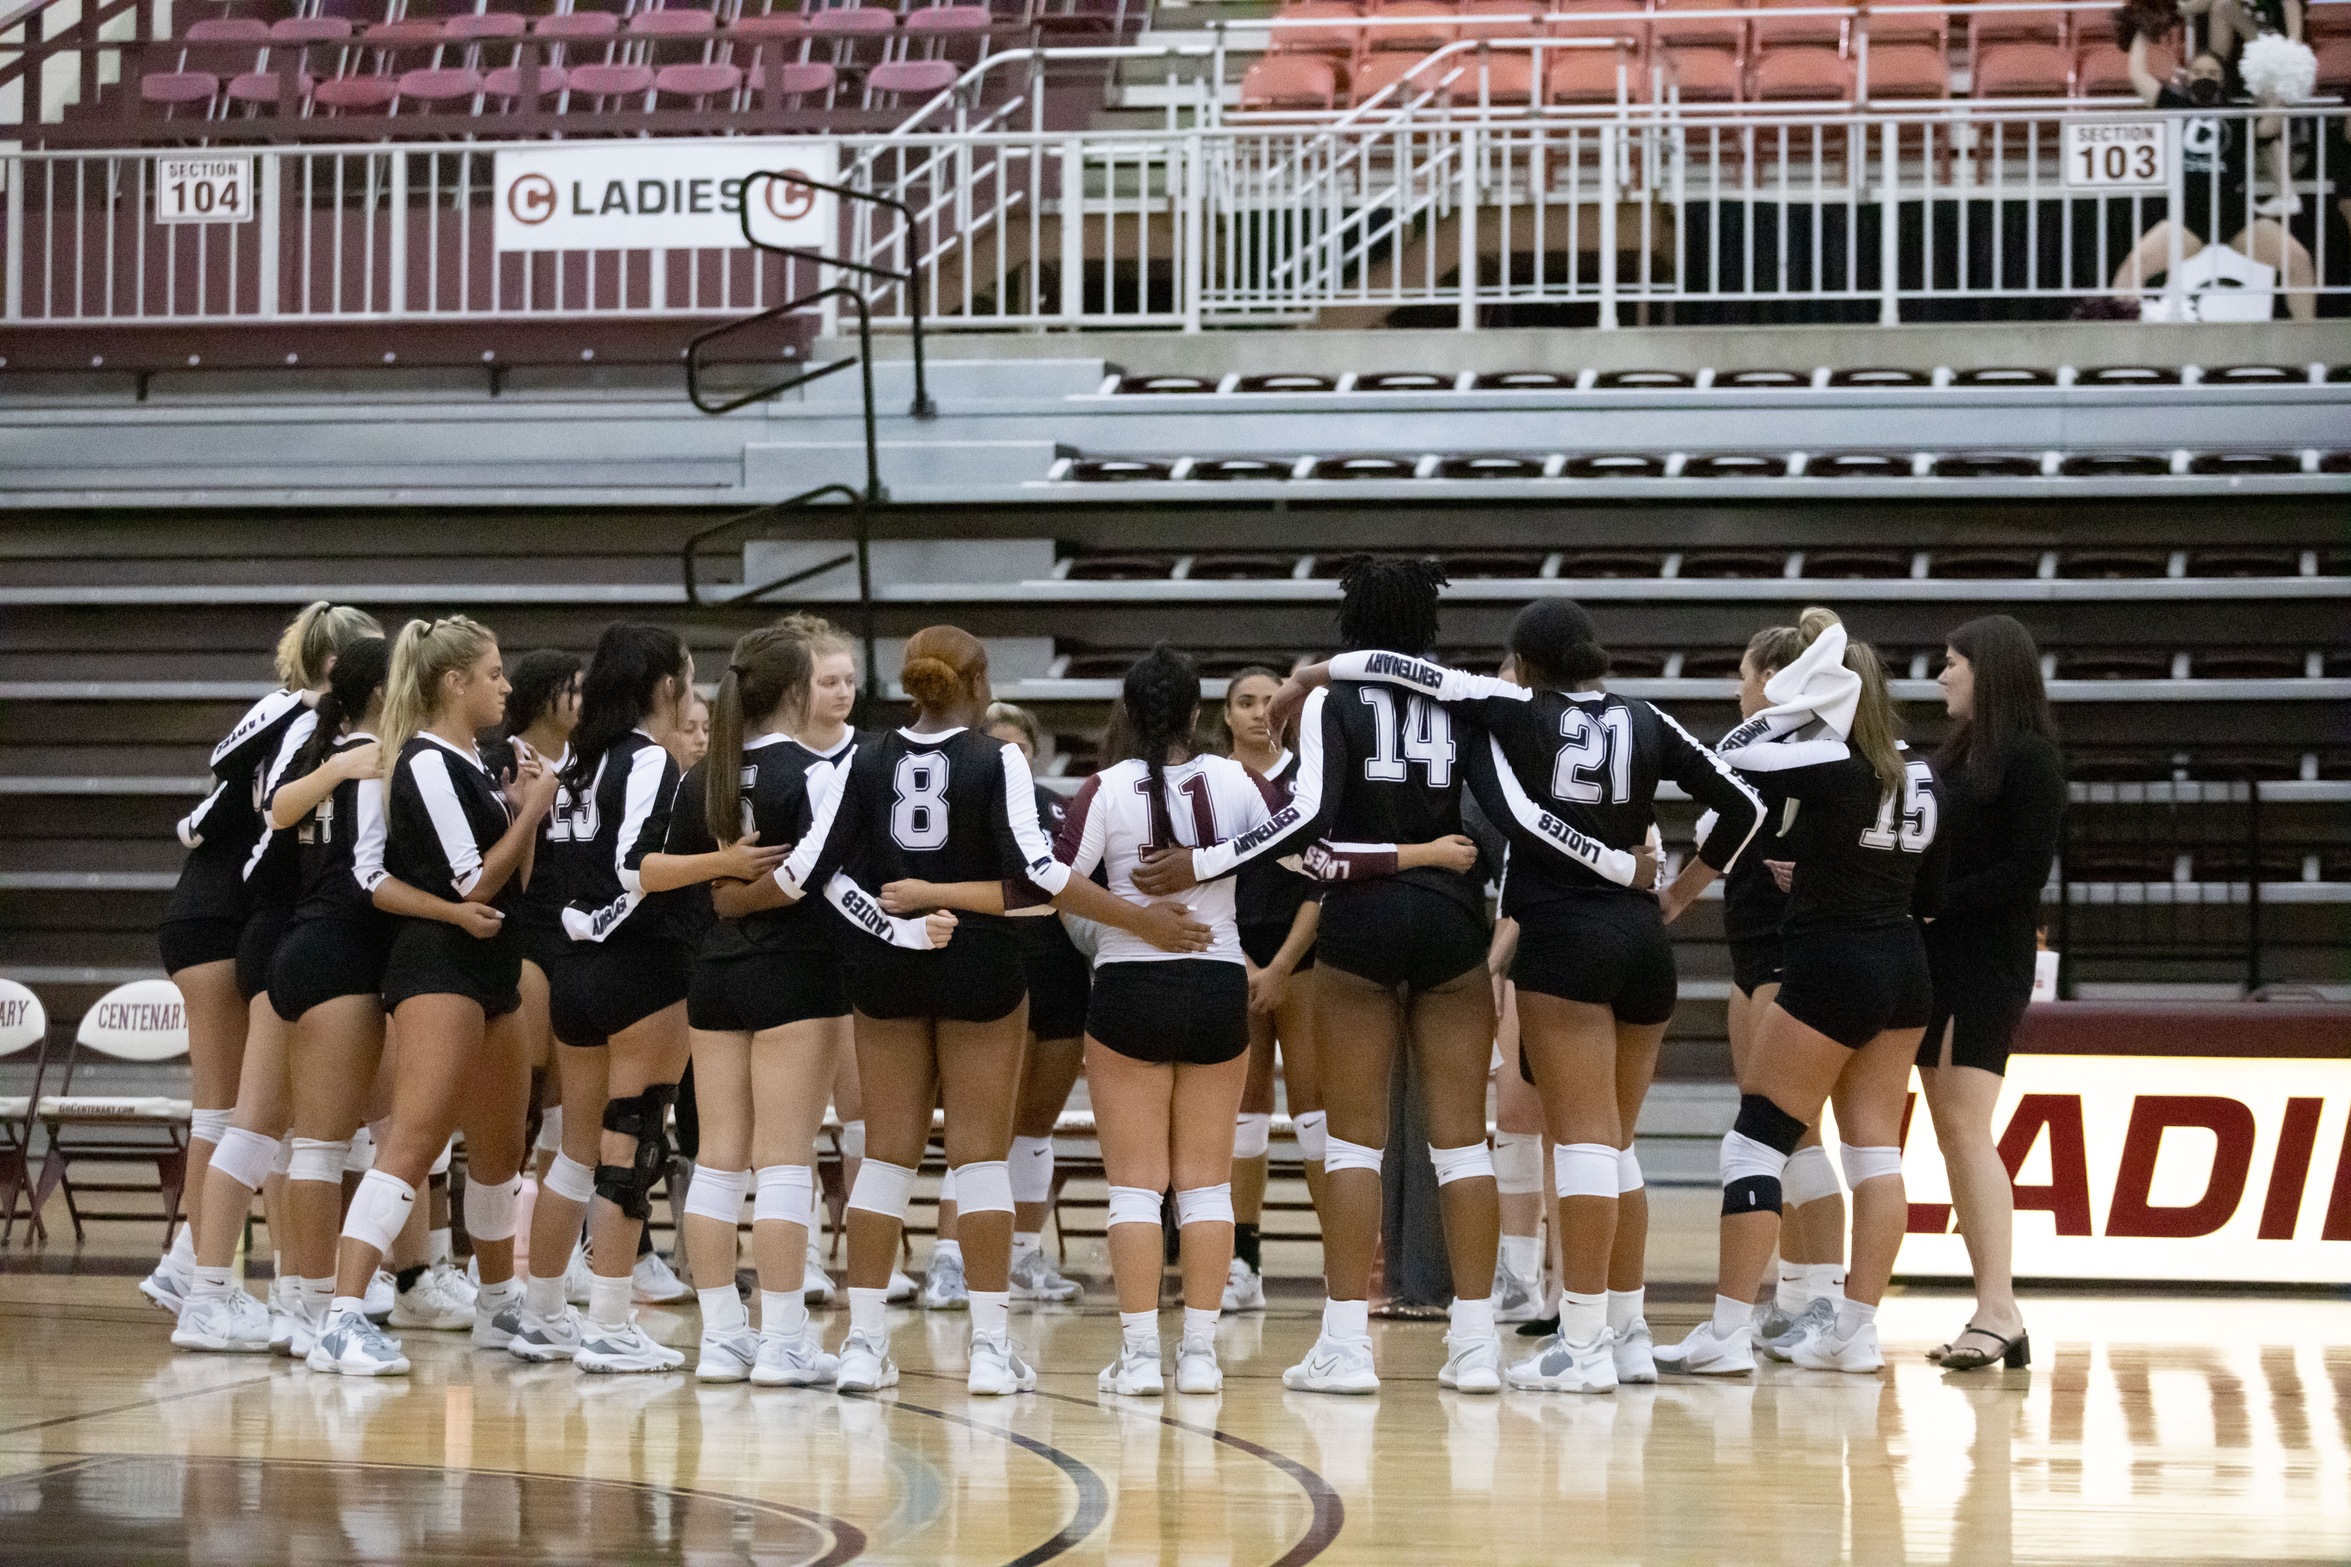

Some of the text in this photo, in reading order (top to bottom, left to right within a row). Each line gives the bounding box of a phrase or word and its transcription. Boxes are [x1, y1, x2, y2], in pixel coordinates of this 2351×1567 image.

[169, 163, 238, 178] SECTION
[2079, 145, 2156, 179] 103
[171, 180, 239, 213] 104
[573, 178, 747, 216] LADIES
[1364, 652, 1443, 690] CENTENARY
[1359, 685, 1456, 788] 14
[1551, 705, 1633, 804] 21
[890, 750, 949, 851] 8
[1134, 771, 1228, 863] 11
[1859, 761, 1937, 852] 15
[1233, 807, 1301, 856] CENTENARY
[1538, 812, 1602, 864] LADIES
